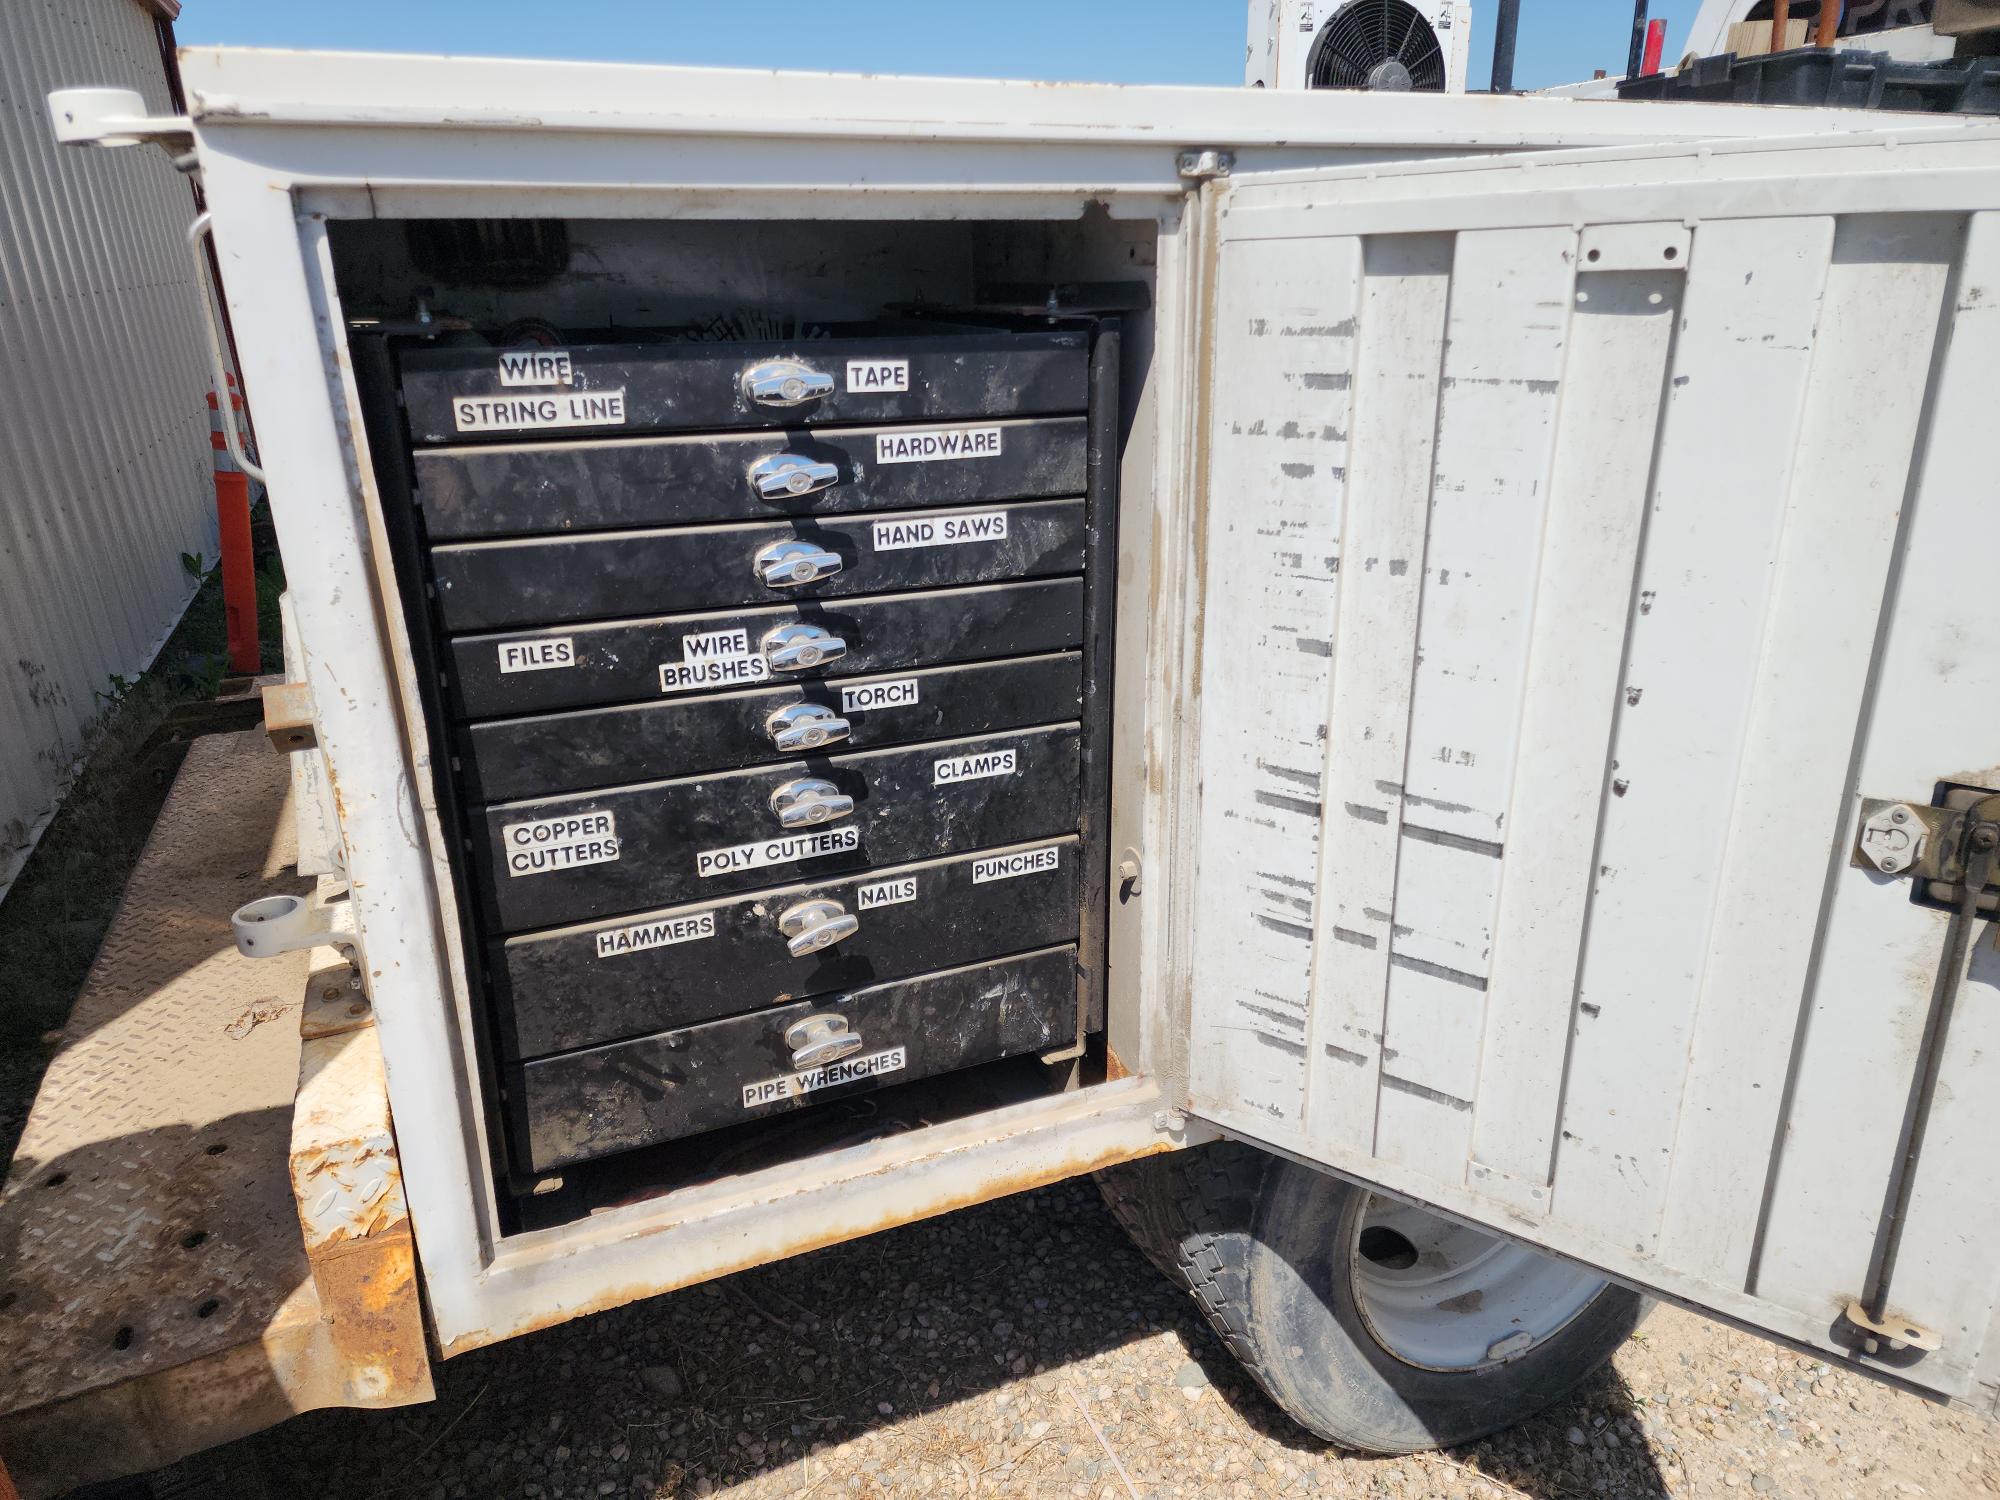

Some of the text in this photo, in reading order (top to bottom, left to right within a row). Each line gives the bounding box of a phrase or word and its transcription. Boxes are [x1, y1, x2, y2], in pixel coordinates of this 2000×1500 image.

[502, 357, 569, 380] WIRE
[851, 367, 905, 387] TAPE
[460, 398, 622, 426] STRING LINE
[880, 432, 998, 458] HARDWARE
[876, 516, 1004, 547] HAND SAWS
[507, 643, 570, 667] FILES
[686, 635, 745, 657] WIRE
[663, 658, 764, 686] BRUSHES
[844, 683, 915, 709] TORCH
[937, 753, 1013, 779] CLAMPS
[513, 815, 609, 846] COPPER
[511, 839, 618, 872] CUTTERS
[700, 830, 856, 873] POLY CUTTERS
[974, 850, 1056, 879] PUNCHES
[860, 881, 915, 906] NAILS
[600, 916, 713, 953] HAMMERS
[744, 1051, 902, 1105] PIPE WRENCHES
